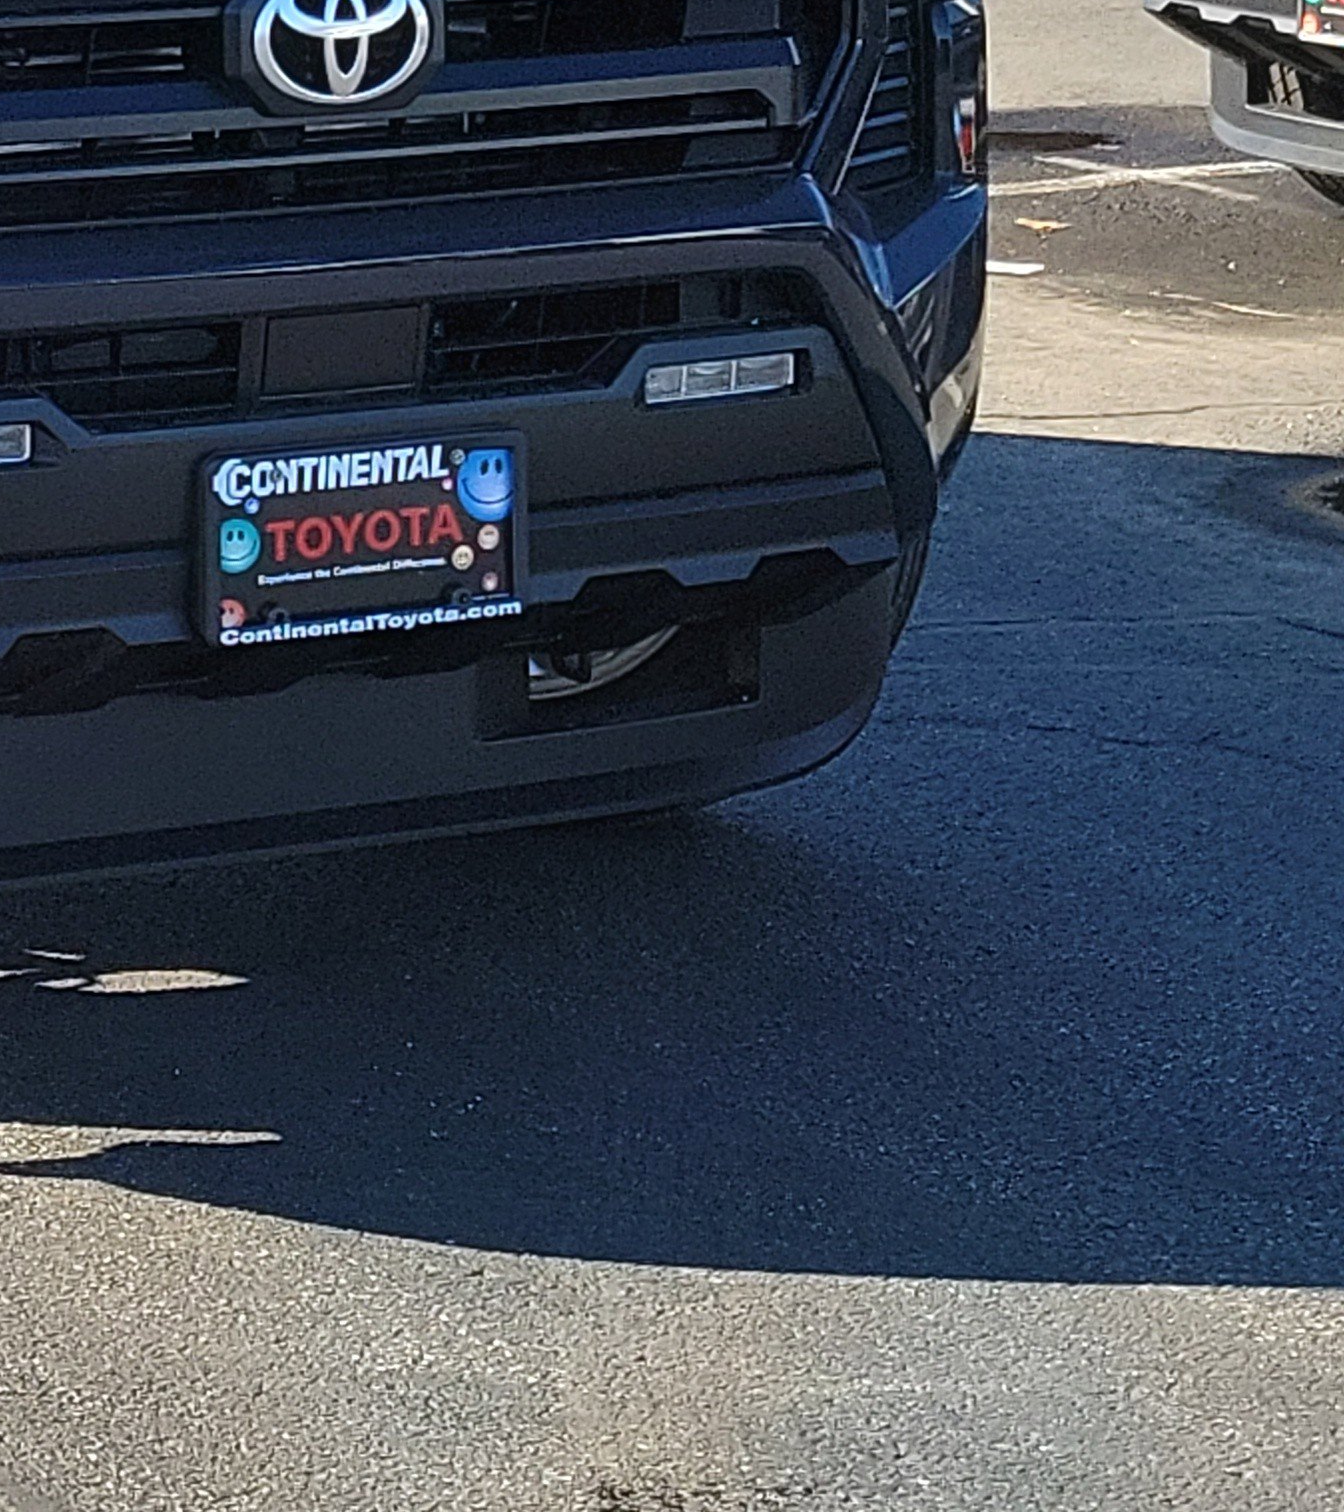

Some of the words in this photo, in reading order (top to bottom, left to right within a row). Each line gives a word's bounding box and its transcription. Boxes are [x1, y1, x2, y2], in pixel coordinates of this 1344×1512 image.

[214, 444, 450, 506] CONTINENTAL
[265, 503, 463, 563] TOYOTA
[219, 599, 523, 647] ContinentalToyota.com
